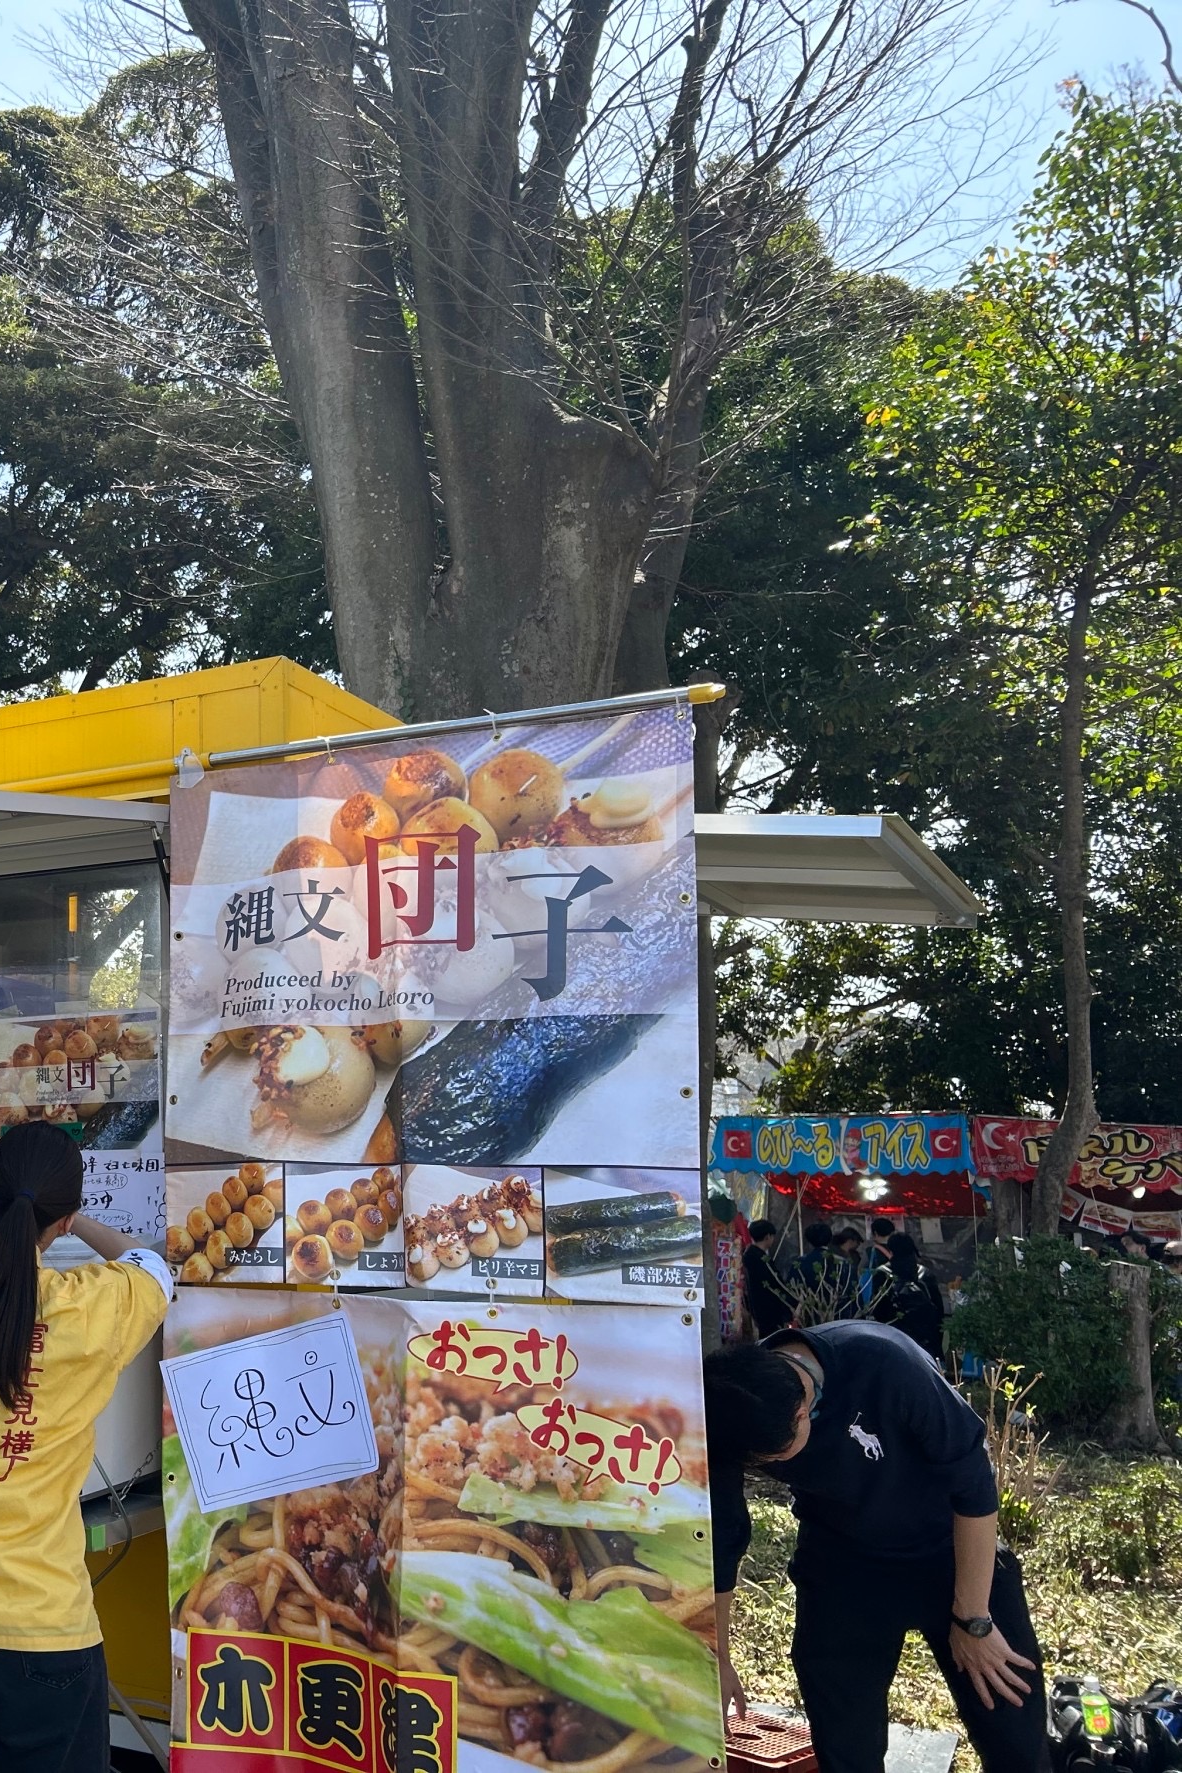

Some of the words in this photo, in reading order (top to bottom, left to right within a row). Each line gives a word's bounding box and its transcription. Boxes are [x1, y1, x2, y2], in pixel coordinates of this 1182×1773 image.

[225, 971, 322, 995] Produceed
[331, 971, 358, 990] by
[221, 994, 276, 1018] Fujimi
[282, 994, 371, 1013] yokocho
[862, 1121, 930, 1169] アイス
[229, 1248, 279, 1265] みたらし
[477, 1259, 541, 1276] ピリ辛マヨ
[627, 1266, 697, 1286] 磯部焼き
